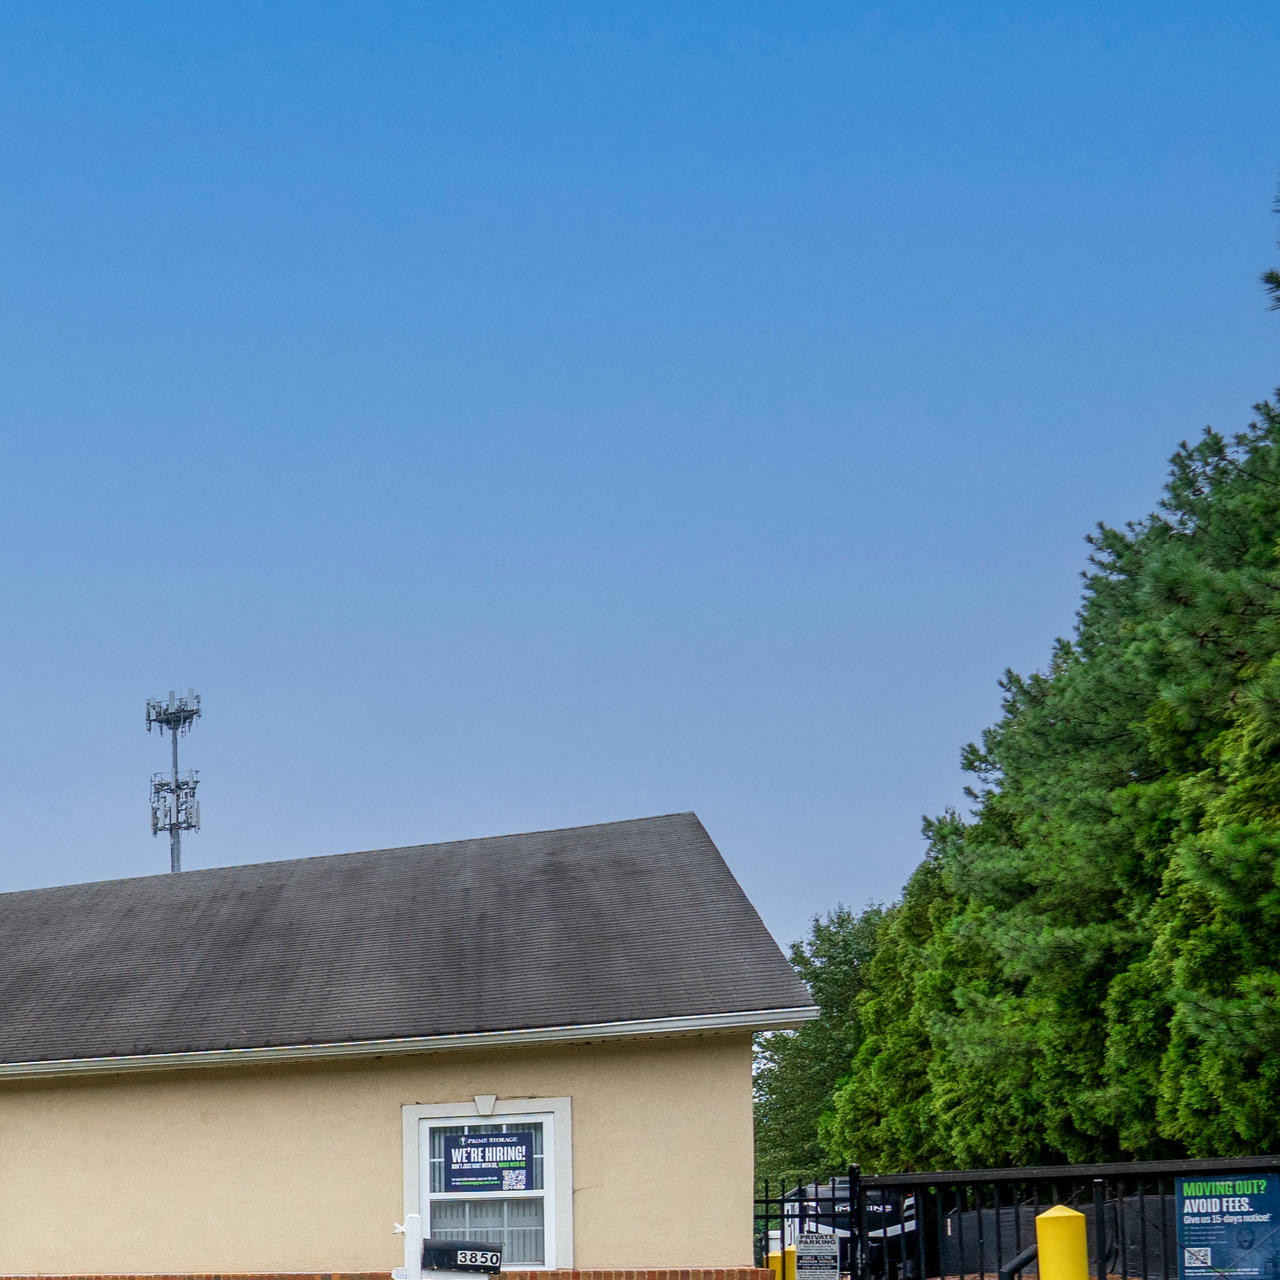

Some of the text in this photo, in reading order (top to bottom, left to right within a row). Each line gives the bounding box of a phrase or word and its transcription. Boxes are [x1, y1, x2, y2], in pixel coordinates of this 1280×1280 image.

[451, 1146, 526, 1162] WE'RE HIRING!
[1183, 1180, 1267, 1196] MOVING OUT?
[1183, 1197, 1254, 1213] AVOID FEES.
[1183, 1215, 1200, 1224] Give
[459, 1252, 499, 1265] 3850
